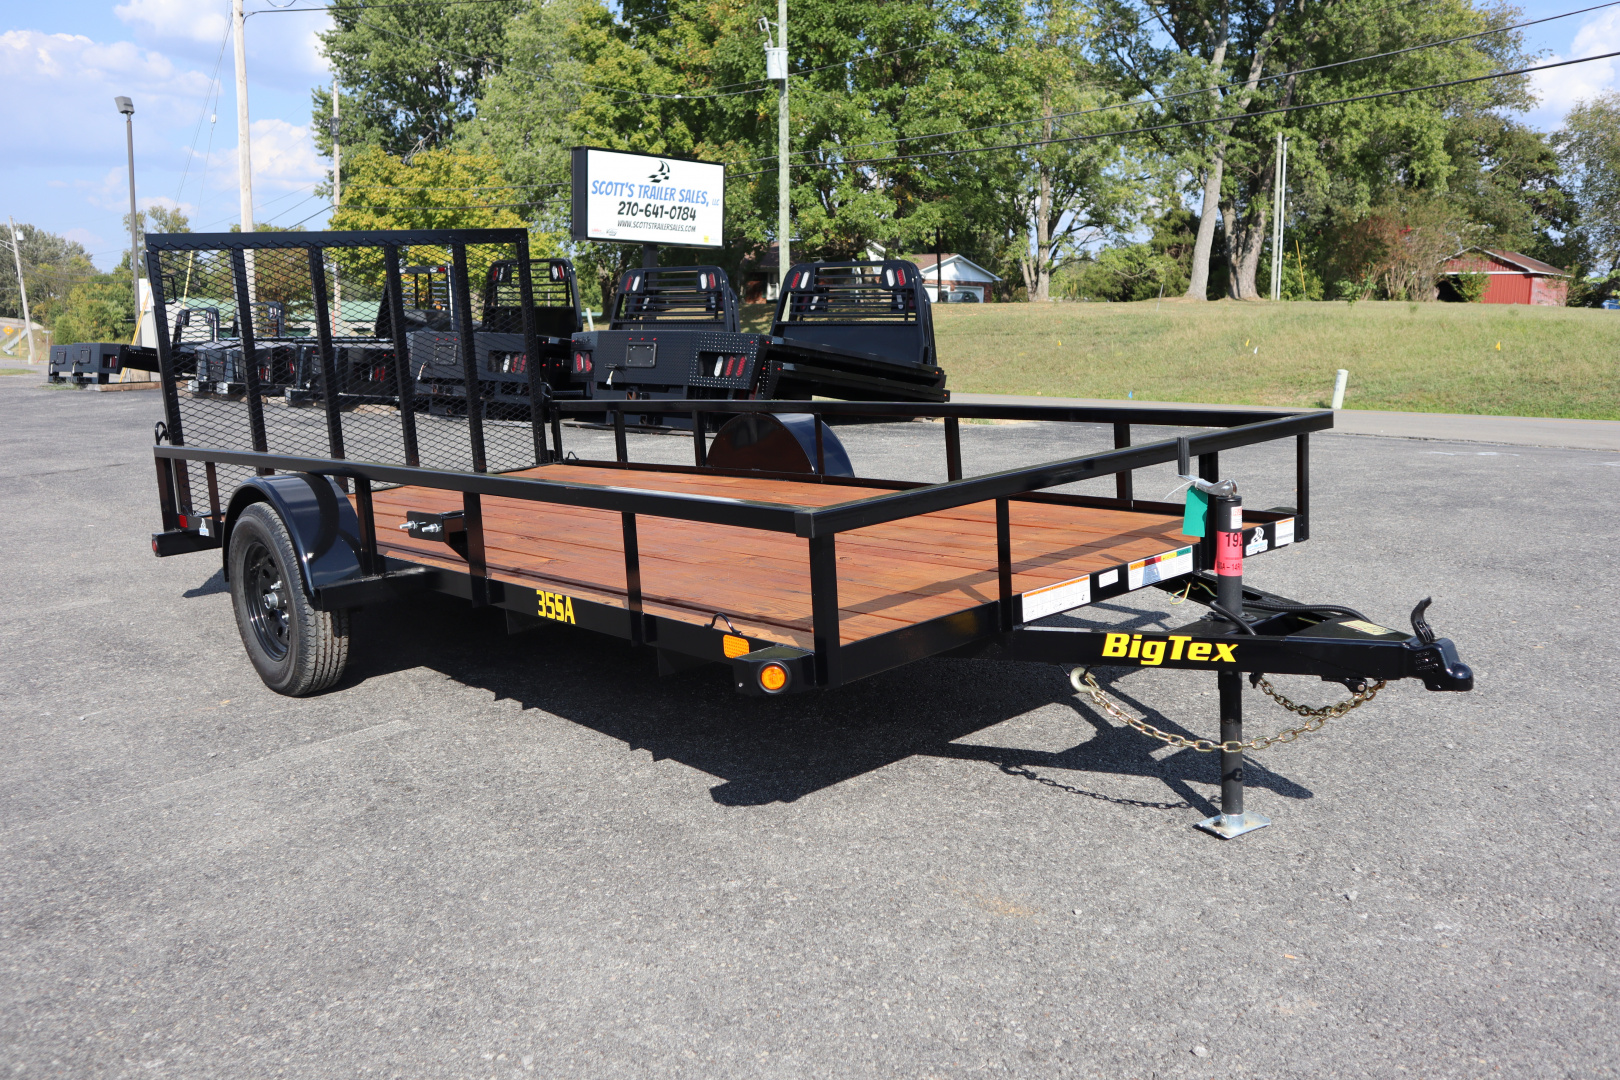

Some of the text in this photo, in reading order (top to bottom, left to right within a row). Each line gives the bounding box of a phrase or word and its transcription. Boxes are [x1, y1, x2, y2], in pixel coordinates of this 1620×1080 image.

[591, 180, 635, 198] SCOTT'S
[638, 184, 676, 201] TRAILER
[678, 188, 709, 207] SALES,
[617, 200, 697, 221] 270-641-0784
[617, 220, 697, 232] WWW.SCOTTSTRAILERSALES.COM
[536, 589, 576, 625] 35SA
[1102, 632, 1239, 666] BigTex
